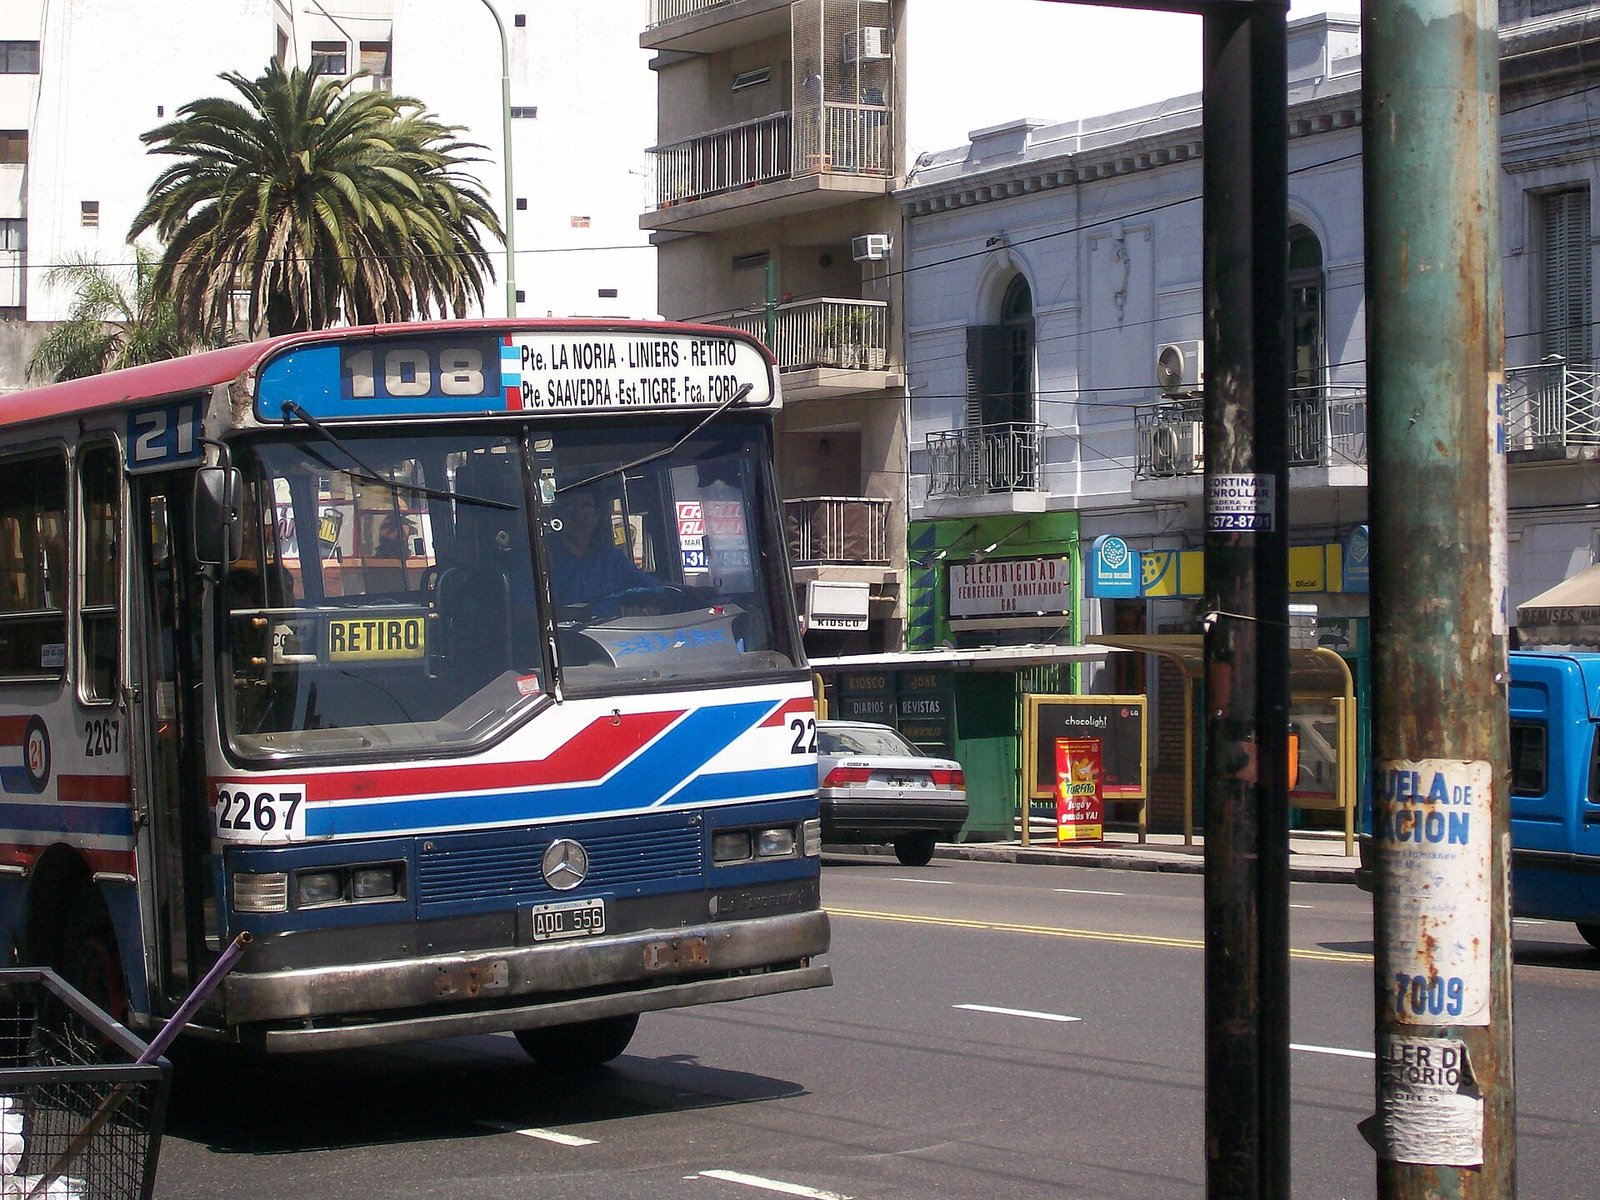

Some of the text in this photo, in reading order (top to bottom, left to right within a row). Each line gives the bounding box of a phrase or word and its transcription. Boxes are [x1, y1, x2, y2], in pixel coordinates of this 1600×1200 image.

[521, 339, 737, 371] Pte. LA NORIA LINIERS RETIRO
[345, 348, 485, 397] 108
[522, 380, 544, 408] Pte.
[547, 378, 612, 407] SAAVEDRA
[684, 376, 705, 403] Fca.
[708, 374, 738, 402] FORD
[134, 404, 194, 462] 21
[964, 561, 1056, 585] ELECTRICIDAD
[958, 581, 1062, 599] FERRETERIA SANITARIOS
[1001, 598, 1017, 611] GAS
[817, 619, 859, 628] KIOSCO
[330, 619, 419, 653] RETIRO
[853, 701, 884, 714] DIARIOS
[902, 700, 940, 714] REVISTAS
[1064, 715, 1108, 728] chocolight
[84, 718, 120, 757] 2267
[1453, 785, 1472, 805] DE
[218, 790, 302, 831] 2267
[573, 908, 602, 929] 556
